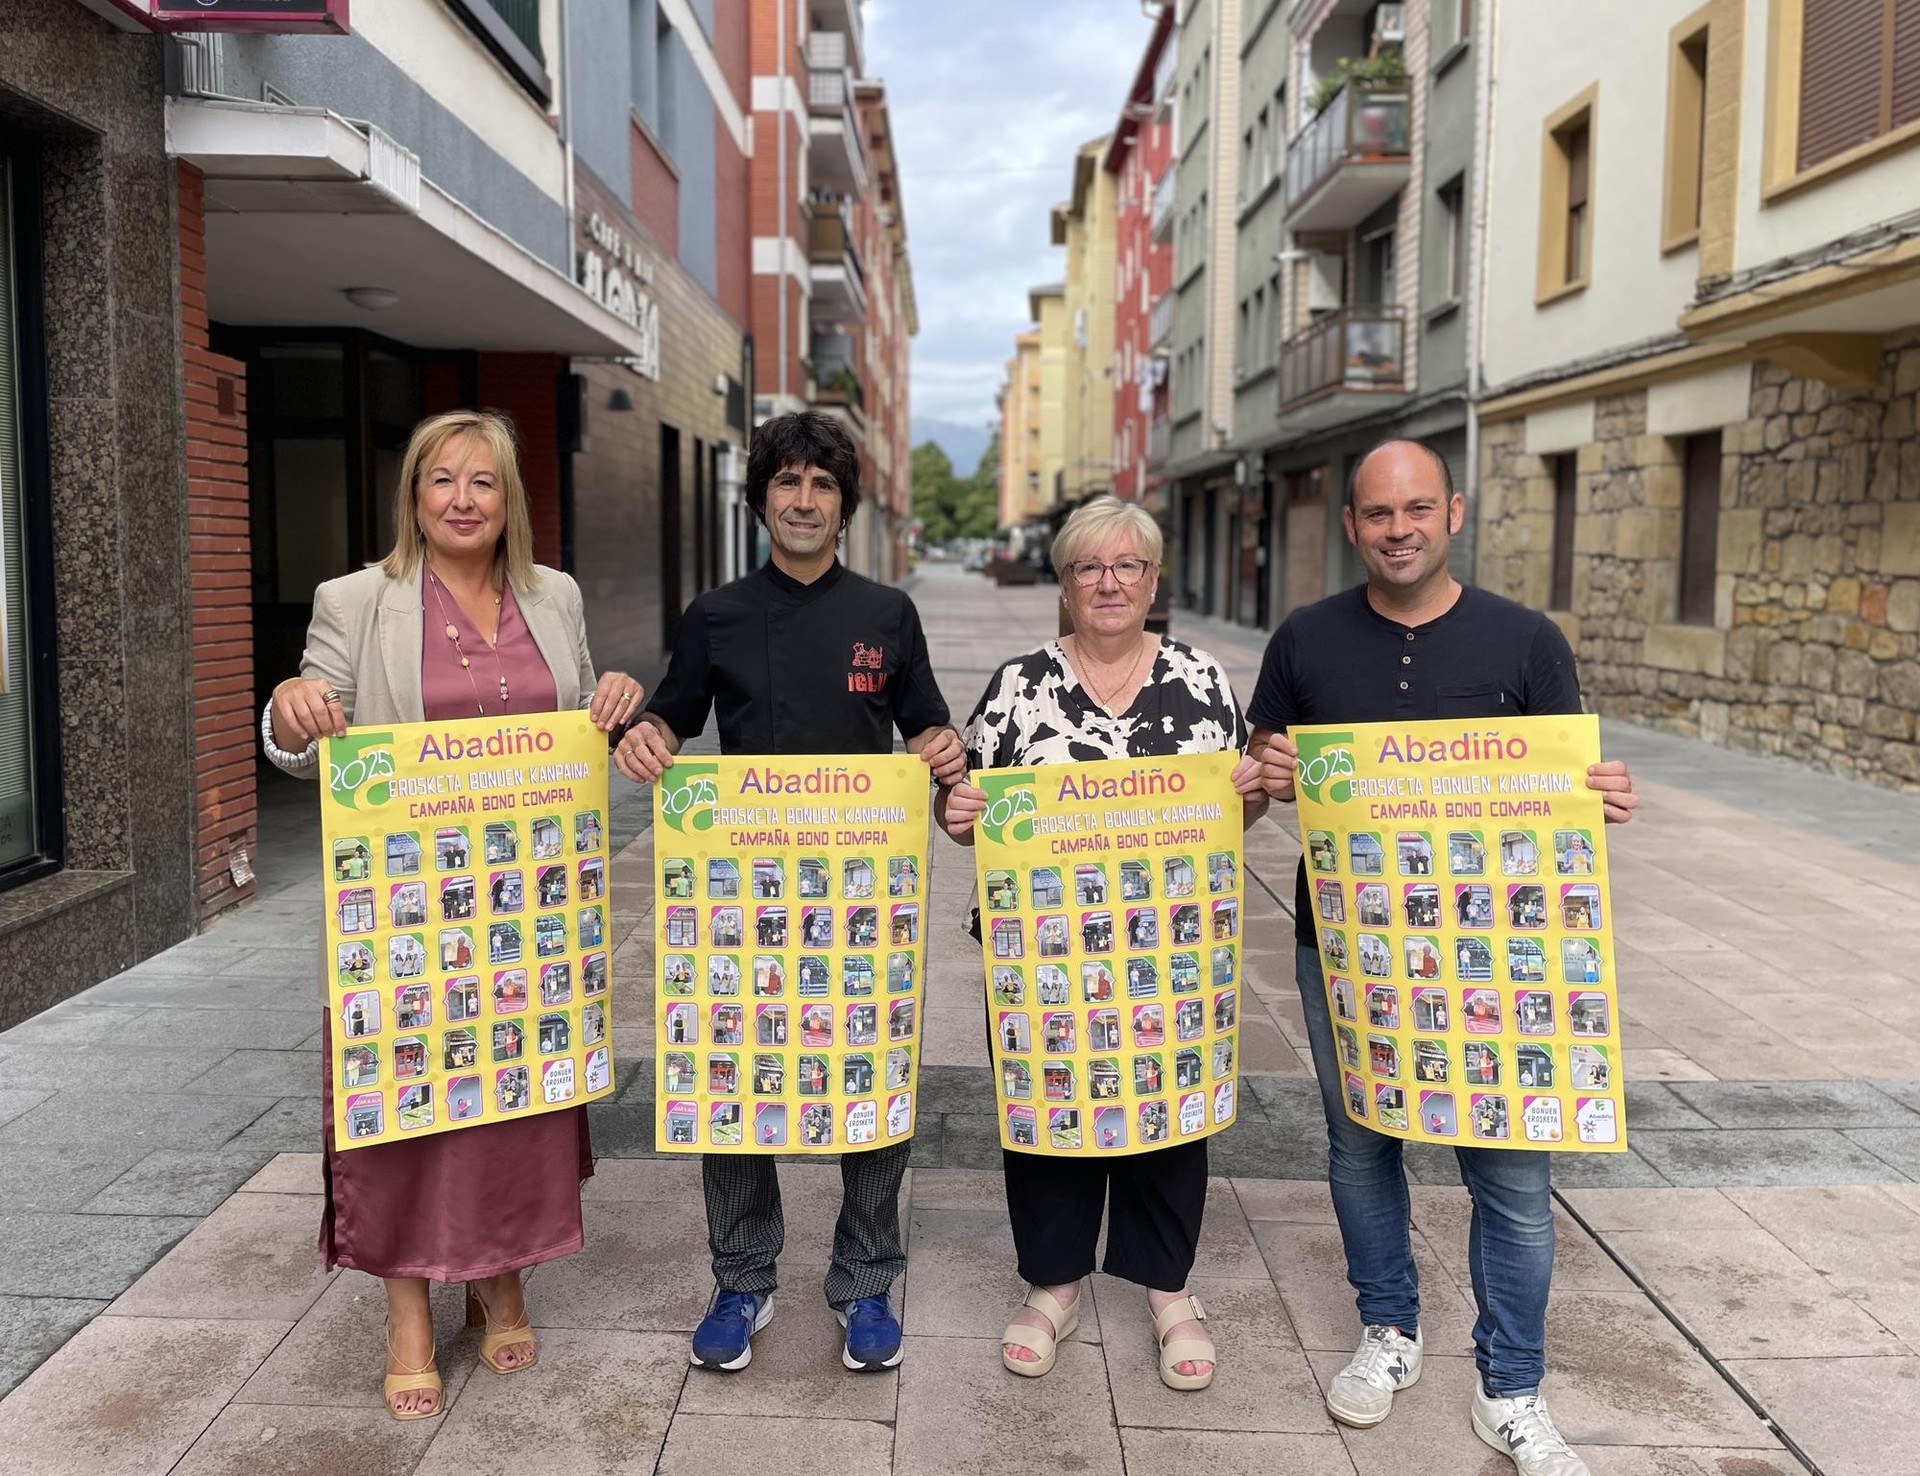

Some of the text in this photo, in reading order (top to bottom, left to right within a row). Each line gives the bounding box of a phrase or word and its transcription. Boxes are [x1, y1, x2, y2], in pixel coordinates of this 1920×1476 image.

[418, 726, 554, 763] Abadiño
[1378, 731, 1528, 764] Abadiño
[329, 750, 394, 792] 2025
[388, 763, 590, 798] EROSKETA BONUEN KANPAINA
[740, 767, 871, 794] Abadiño
[1296, 749, 1353, 786] 2025
[661, 779, 717, 815] 2025
[1057, 768, 1186, 802] Abadiño
[1350, 773, 1572, 797] EROSKETA BONUEN KANPAINA
[410, 787, 574, 819] CAMPAÑA BONO COMPRA
[712, 807, 906, 825] EROSKETA BONUEN KANPAINA
[981, 789, 1035, 827] 2025
[1031, 803, 1222, 835] EROSKETA BONUEN KANPAINA
[1371, 800, 1551, 819] CAMPAÑA BONO COMPRA
[730, 829, 888, 846] CAMPAÑA BONO COMPRA
[1051, 828, 1206, 855] CAMPAÑA BONO COMPRA
